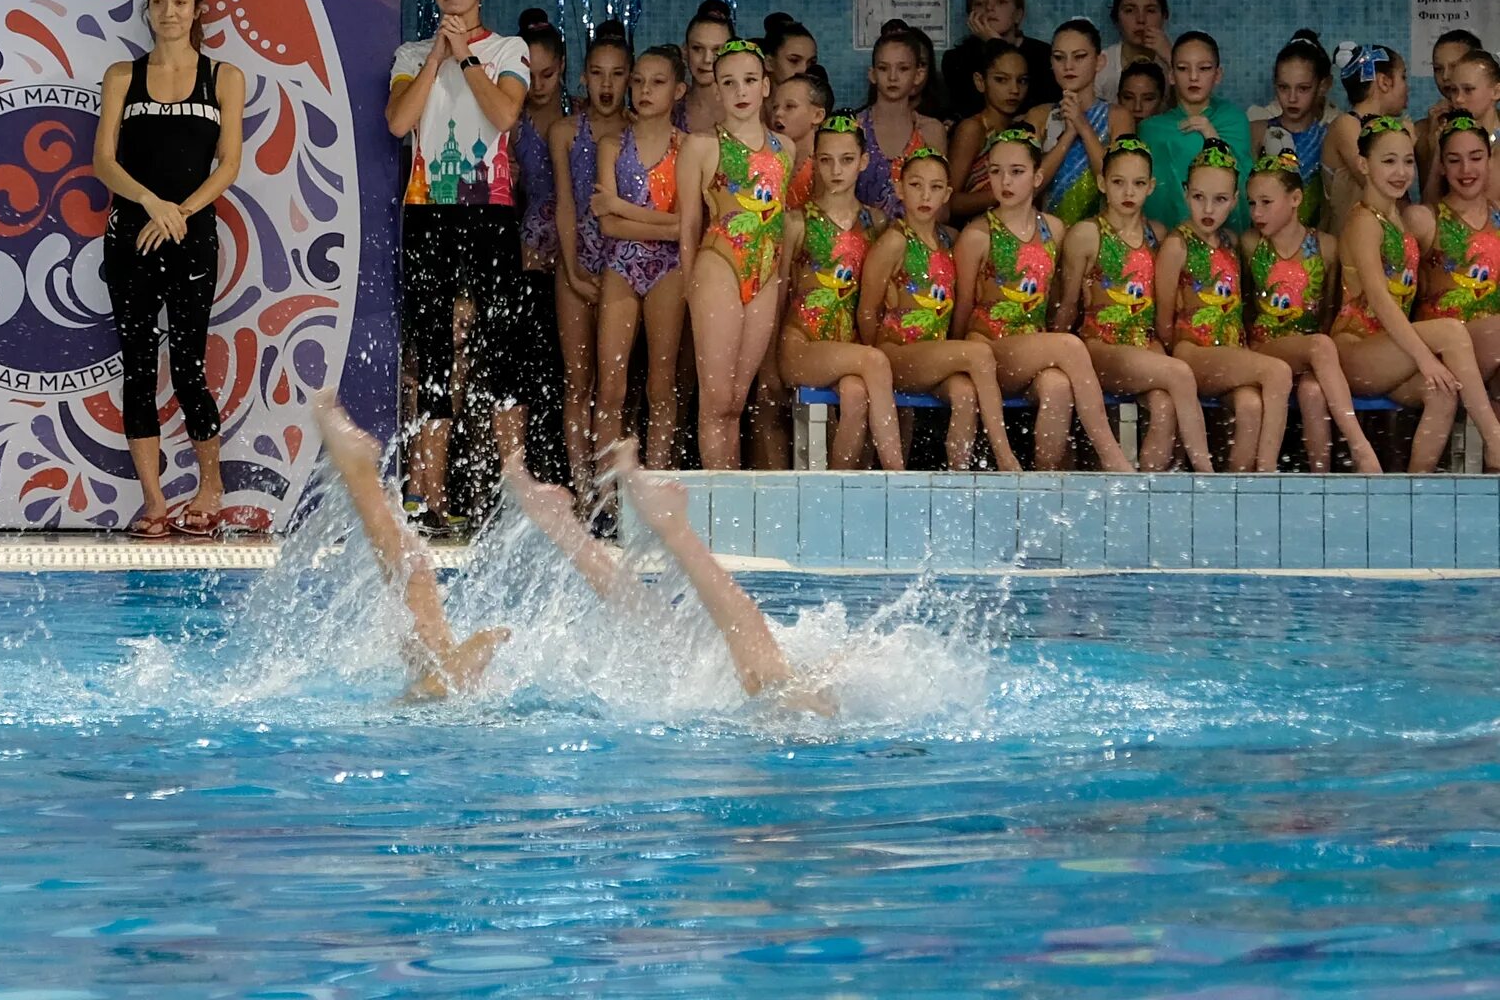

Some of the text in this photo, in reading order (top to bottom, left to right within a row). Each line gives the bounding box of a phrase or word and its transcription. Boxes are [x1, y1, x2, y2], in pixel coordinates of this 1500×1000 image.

[1418, 10, 1470, 22] Фигура 3
[24, 87, 102, 112] MATRY
[39, 355, 124, 392] МАТРЕ
